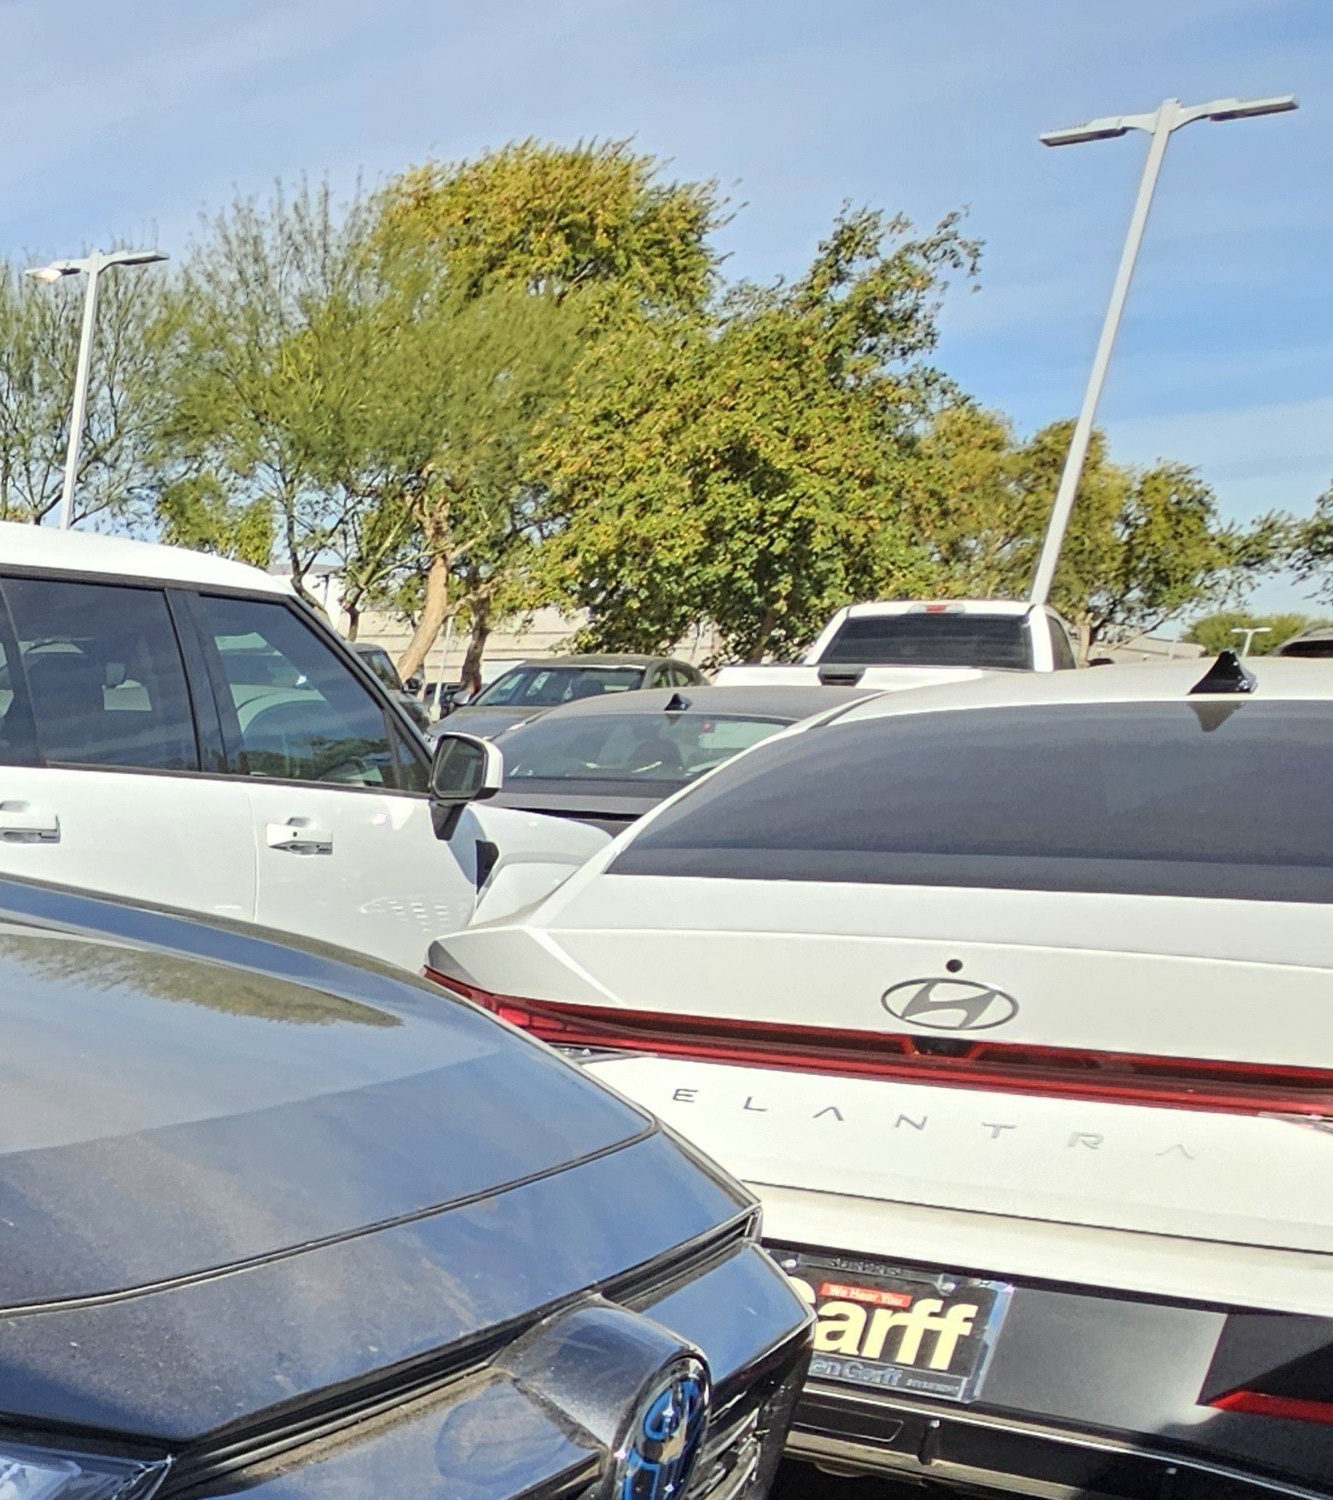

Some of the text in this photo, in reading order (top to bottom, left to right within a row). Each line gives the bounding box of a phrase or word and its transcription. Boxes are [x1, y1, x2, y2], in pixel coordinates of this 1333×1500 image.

[671, 1087, 1196, 1160] ELANTRA
[850, 1288, 881, 1303] Hear
[882, 1292, 906, 1306] You
